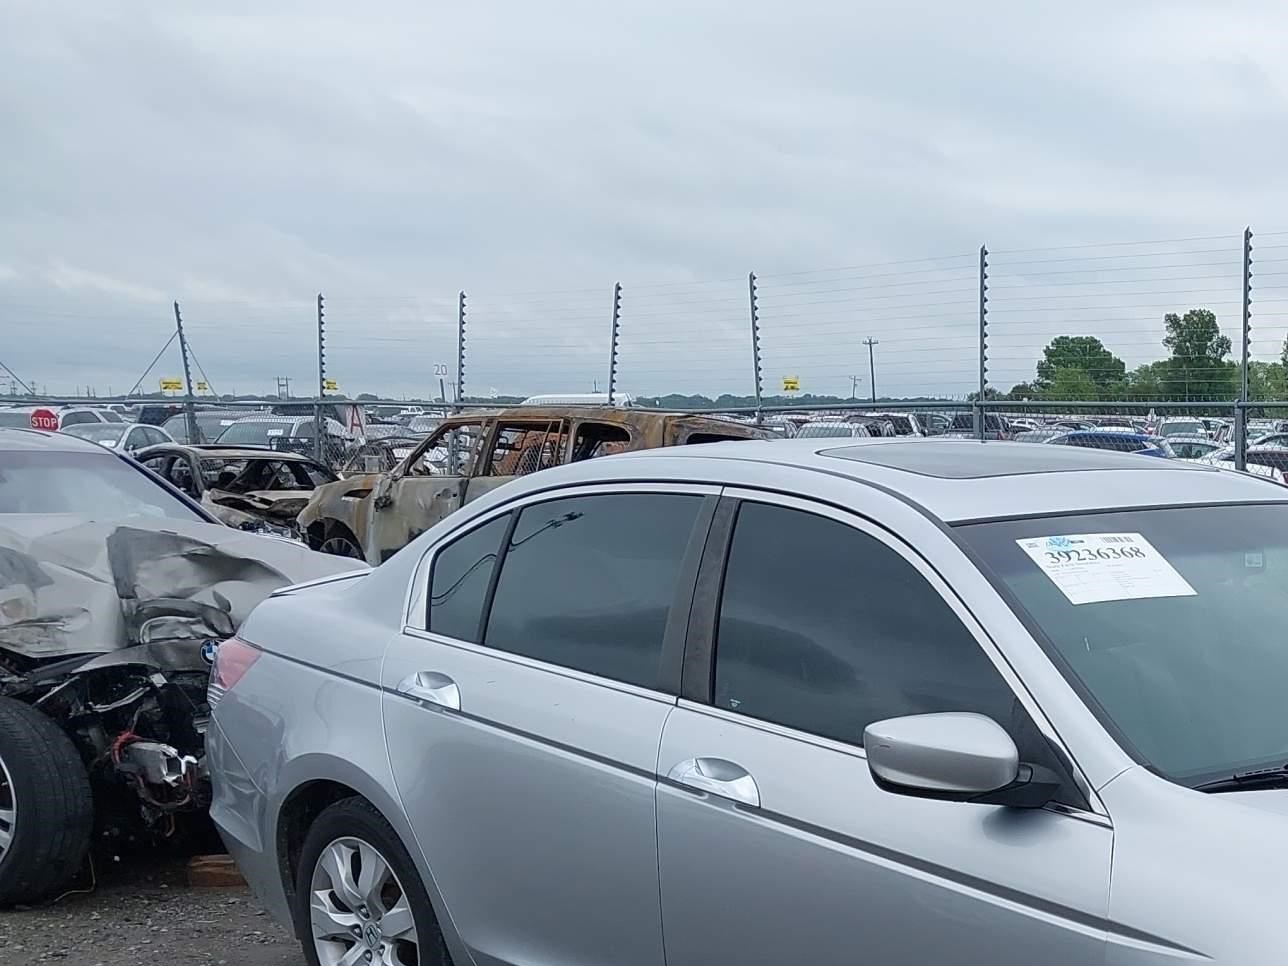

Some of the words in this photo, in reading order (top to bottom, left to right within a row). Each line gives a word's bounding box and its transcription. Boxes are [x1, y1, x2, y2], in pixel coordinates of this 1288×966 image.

[433, 364, 448, 376] 20
[31, 416, 57, 428] STOP
[350, 404, 364, 436] A
[1044, 546, 1147, 564] 39236368
